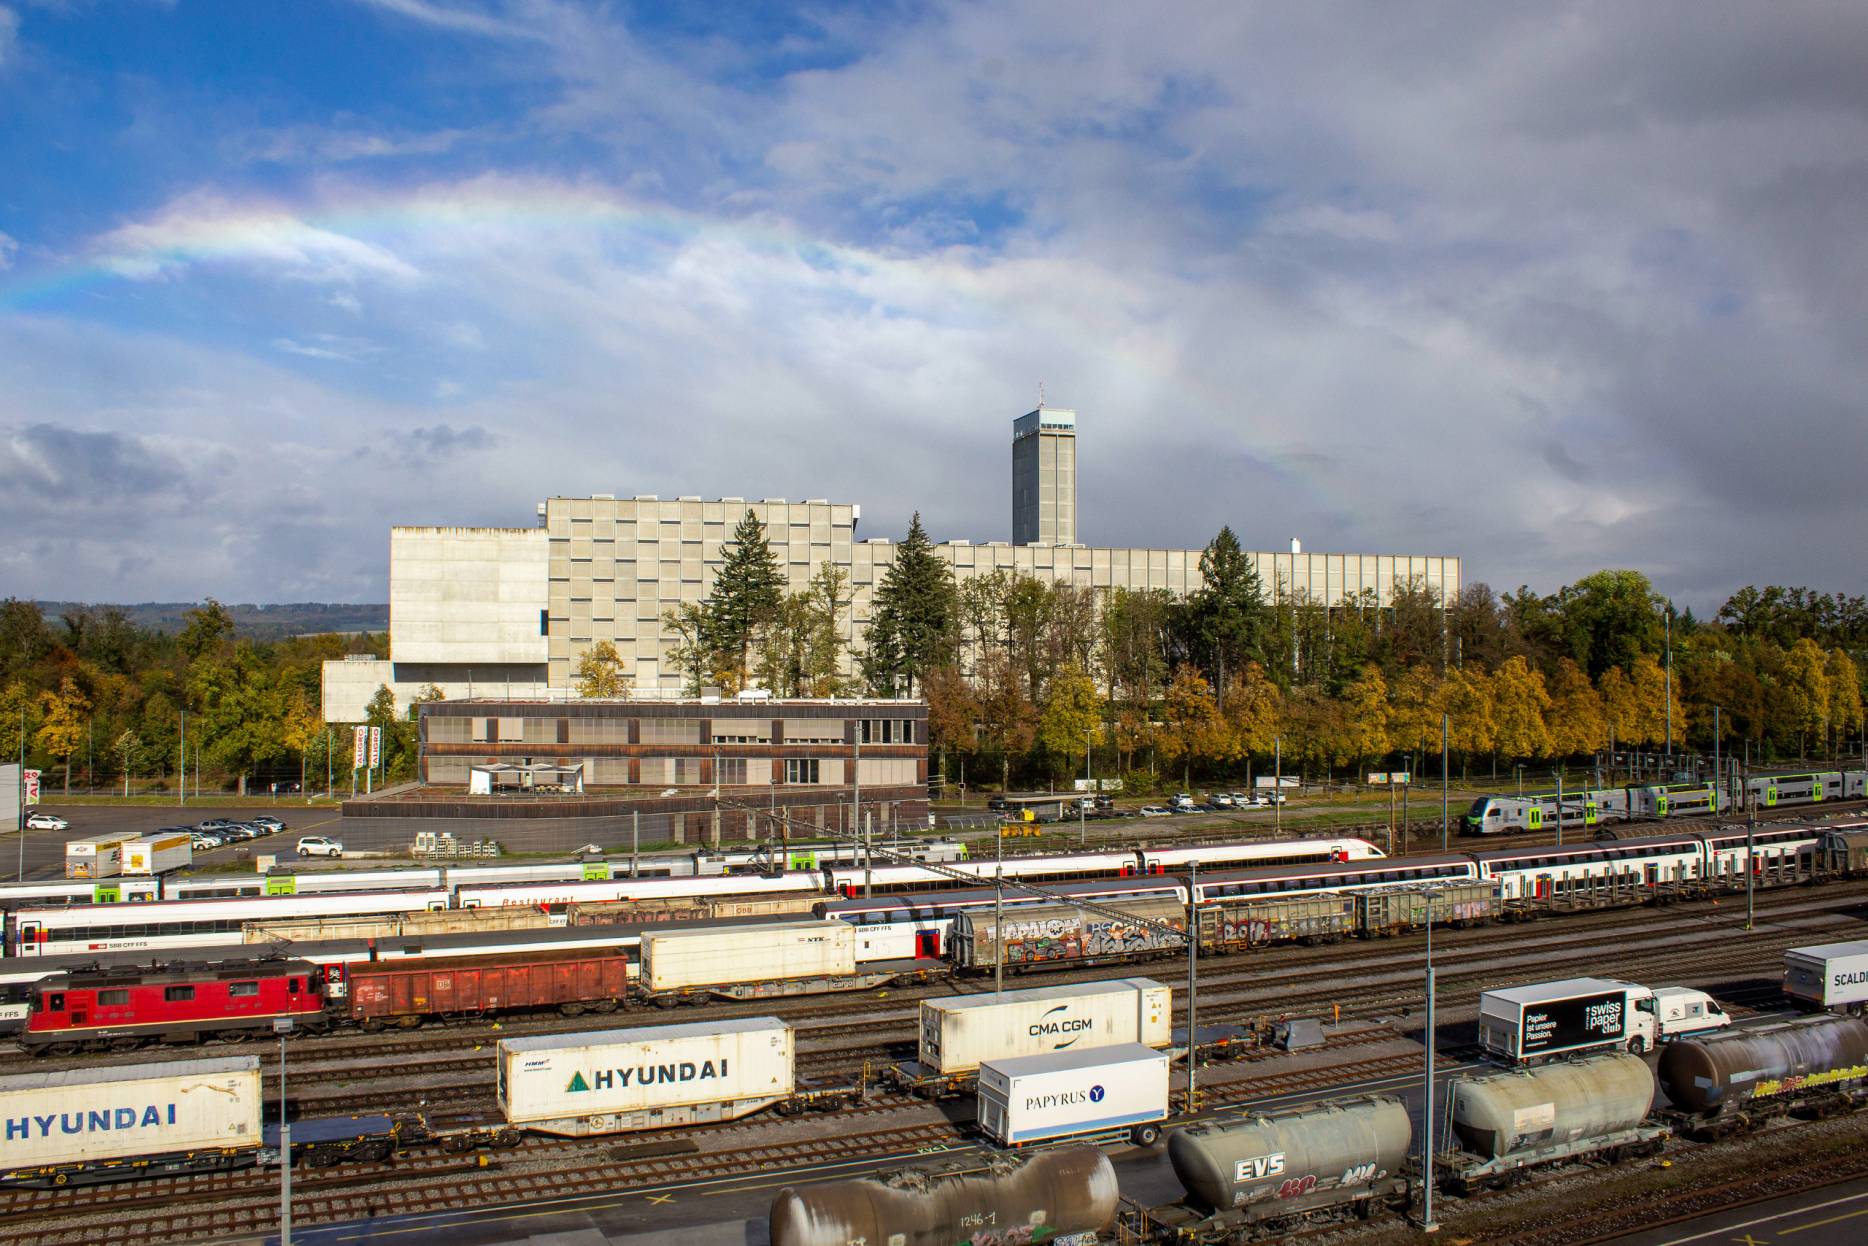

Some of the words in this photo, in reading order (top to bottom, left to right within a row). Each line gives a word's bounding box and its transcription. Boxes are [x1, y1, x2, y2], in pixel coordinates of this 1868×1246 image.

[502, 896, 574, 908] Restaurant
[832, 980, 853, 988] cargo
[1591, 1001, 1621, 1016] swiss
[1029, 1023, 1059, 1036] CMA
[1062, 1018, 1092, 1032] CGM
[1527, 1014, 1548, 1024] Papier
[1536, 1021, 1557, 1030] unsere
[1590, 1013, 1620, 1030] paper
[1527, 1030, 1553, 1041] Passion.
[595, 1058, 728, 1090] HYUNDAI
[1026, 1090, 1086, 1110] PAPYRUS
[6, 1103, 176, 1141] HYUNDAI
[1236, 1154, 1285, 1181] EVS
[960, 1211, 996, 1228] 1246-1
